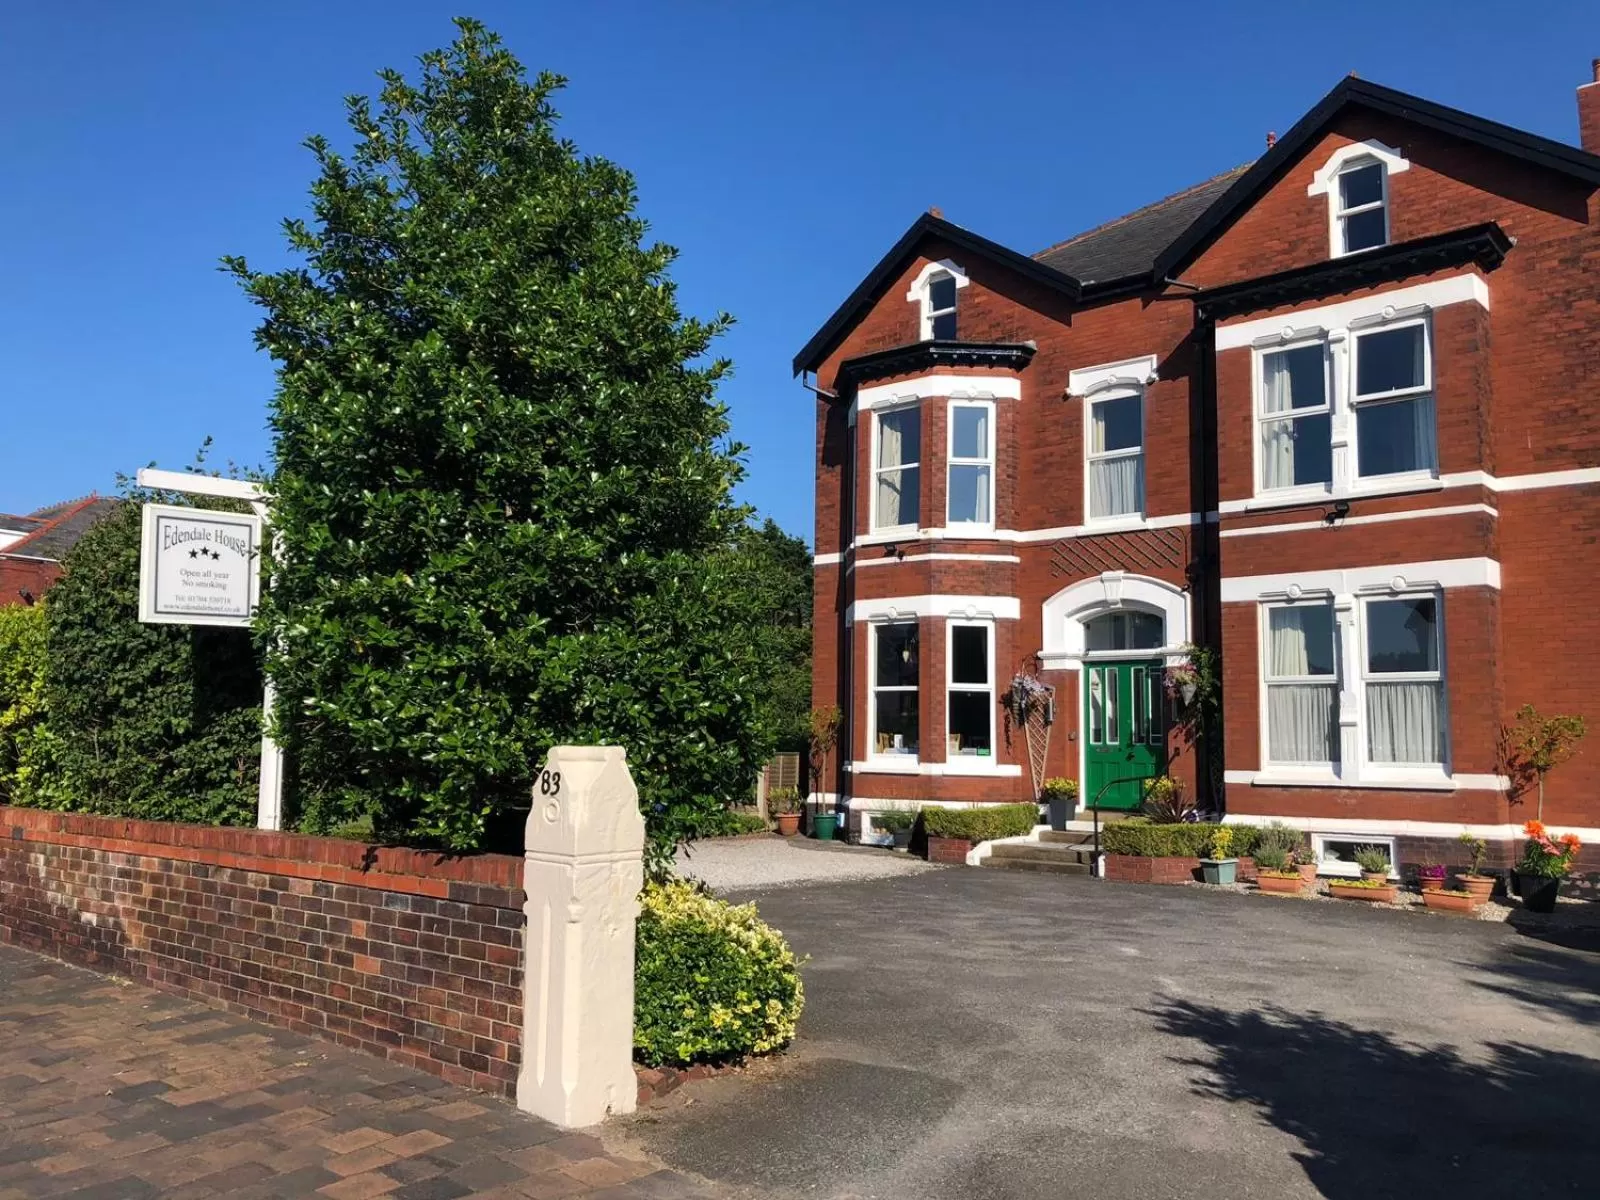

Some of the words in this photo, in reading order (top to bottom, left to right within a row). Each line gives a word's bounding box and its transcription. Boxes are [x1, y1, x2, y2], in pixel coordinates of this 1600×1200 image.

[164, 524, 212, 550] Edendale
[214, 529, 246, 557] House
[180, 568, 200, 577] Open
[202, 569, 212, 577] all
[214, 572, 229, 580] year
[195, 580, 227, 590] smoking
[541, 769, 561, 796] 83
